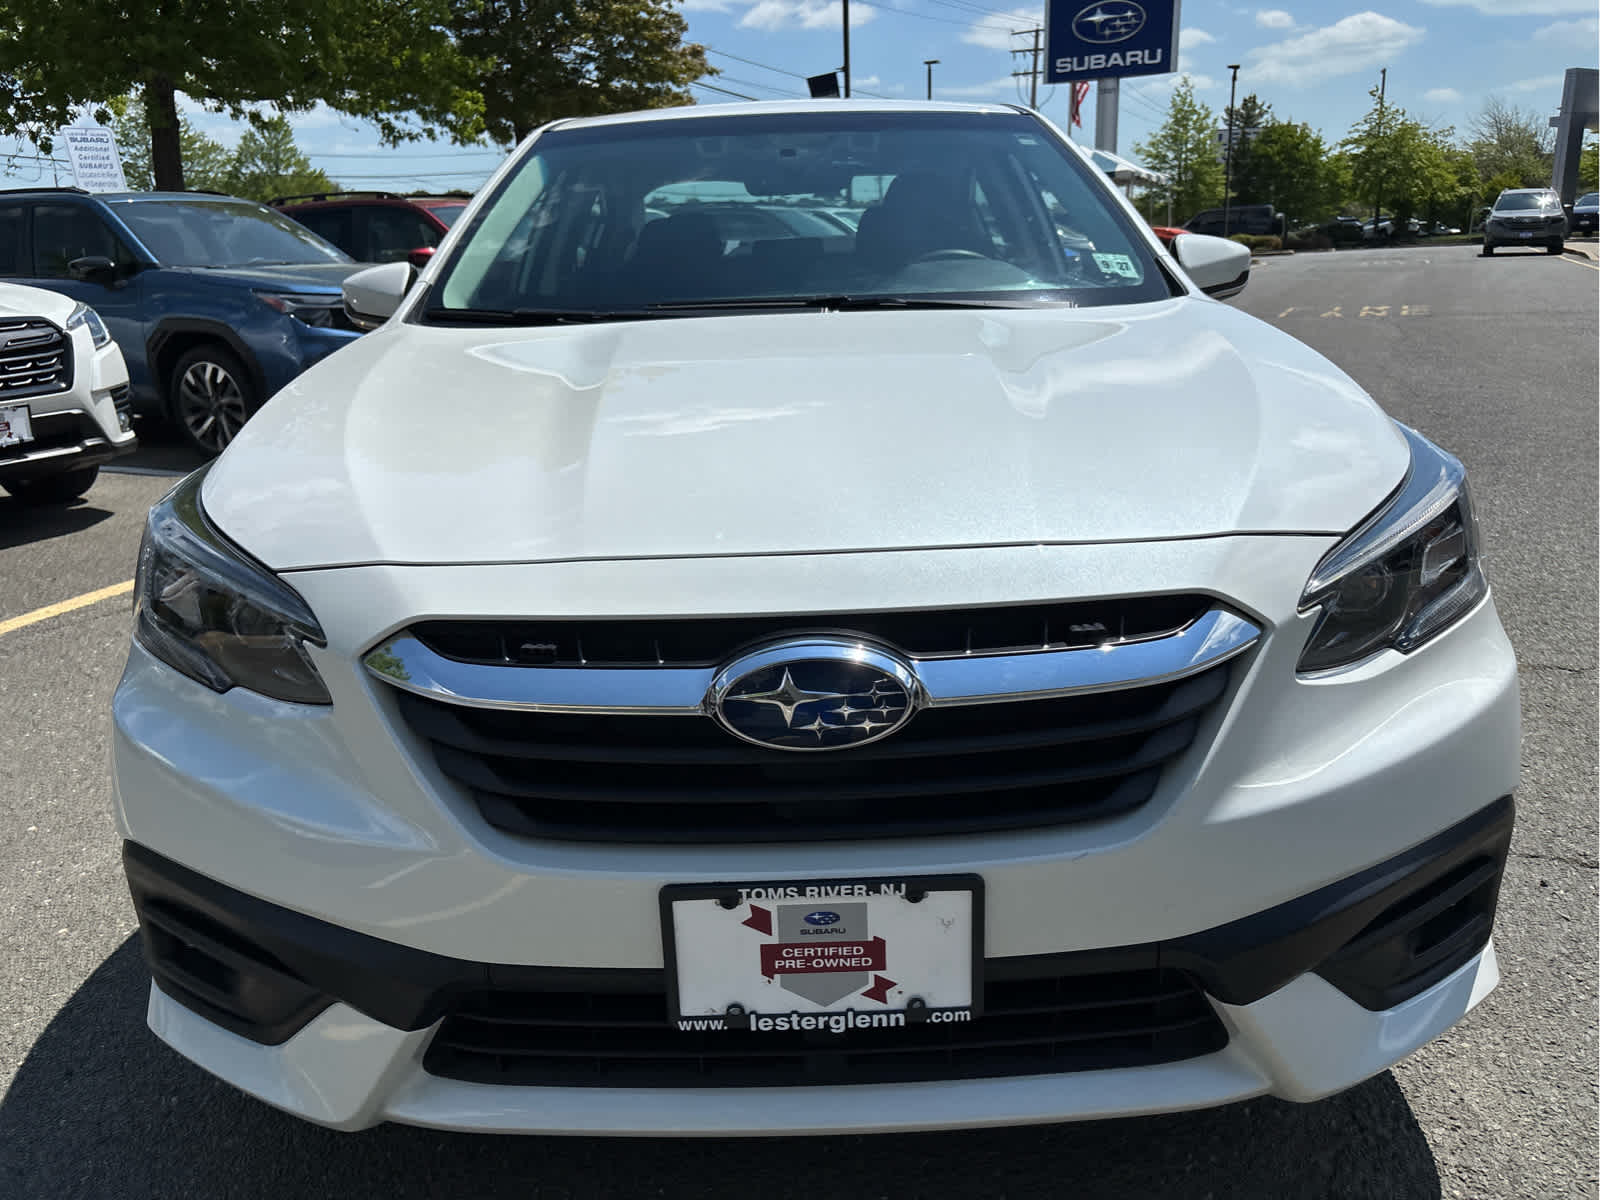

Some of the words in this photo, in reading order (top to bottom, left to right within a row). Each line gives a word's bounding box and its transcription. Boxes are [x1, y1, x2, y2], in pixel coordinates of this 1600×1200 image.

[1056, 48, 1162, 73] SUBARU
[738, 887, 799, 900] TOMS
[880, 883, 907, 897] NJ
[800, 927, 847, 936] SUBARU
[782, 946, 864, 958] CERTIFIED
[774, 957, 873, 970] PRE-OWNED
[678, 1019, 728, 1031] www.
[750, 1010, 905, 1033] lesterglenn
[926, 1009, 971, 1023] .com
